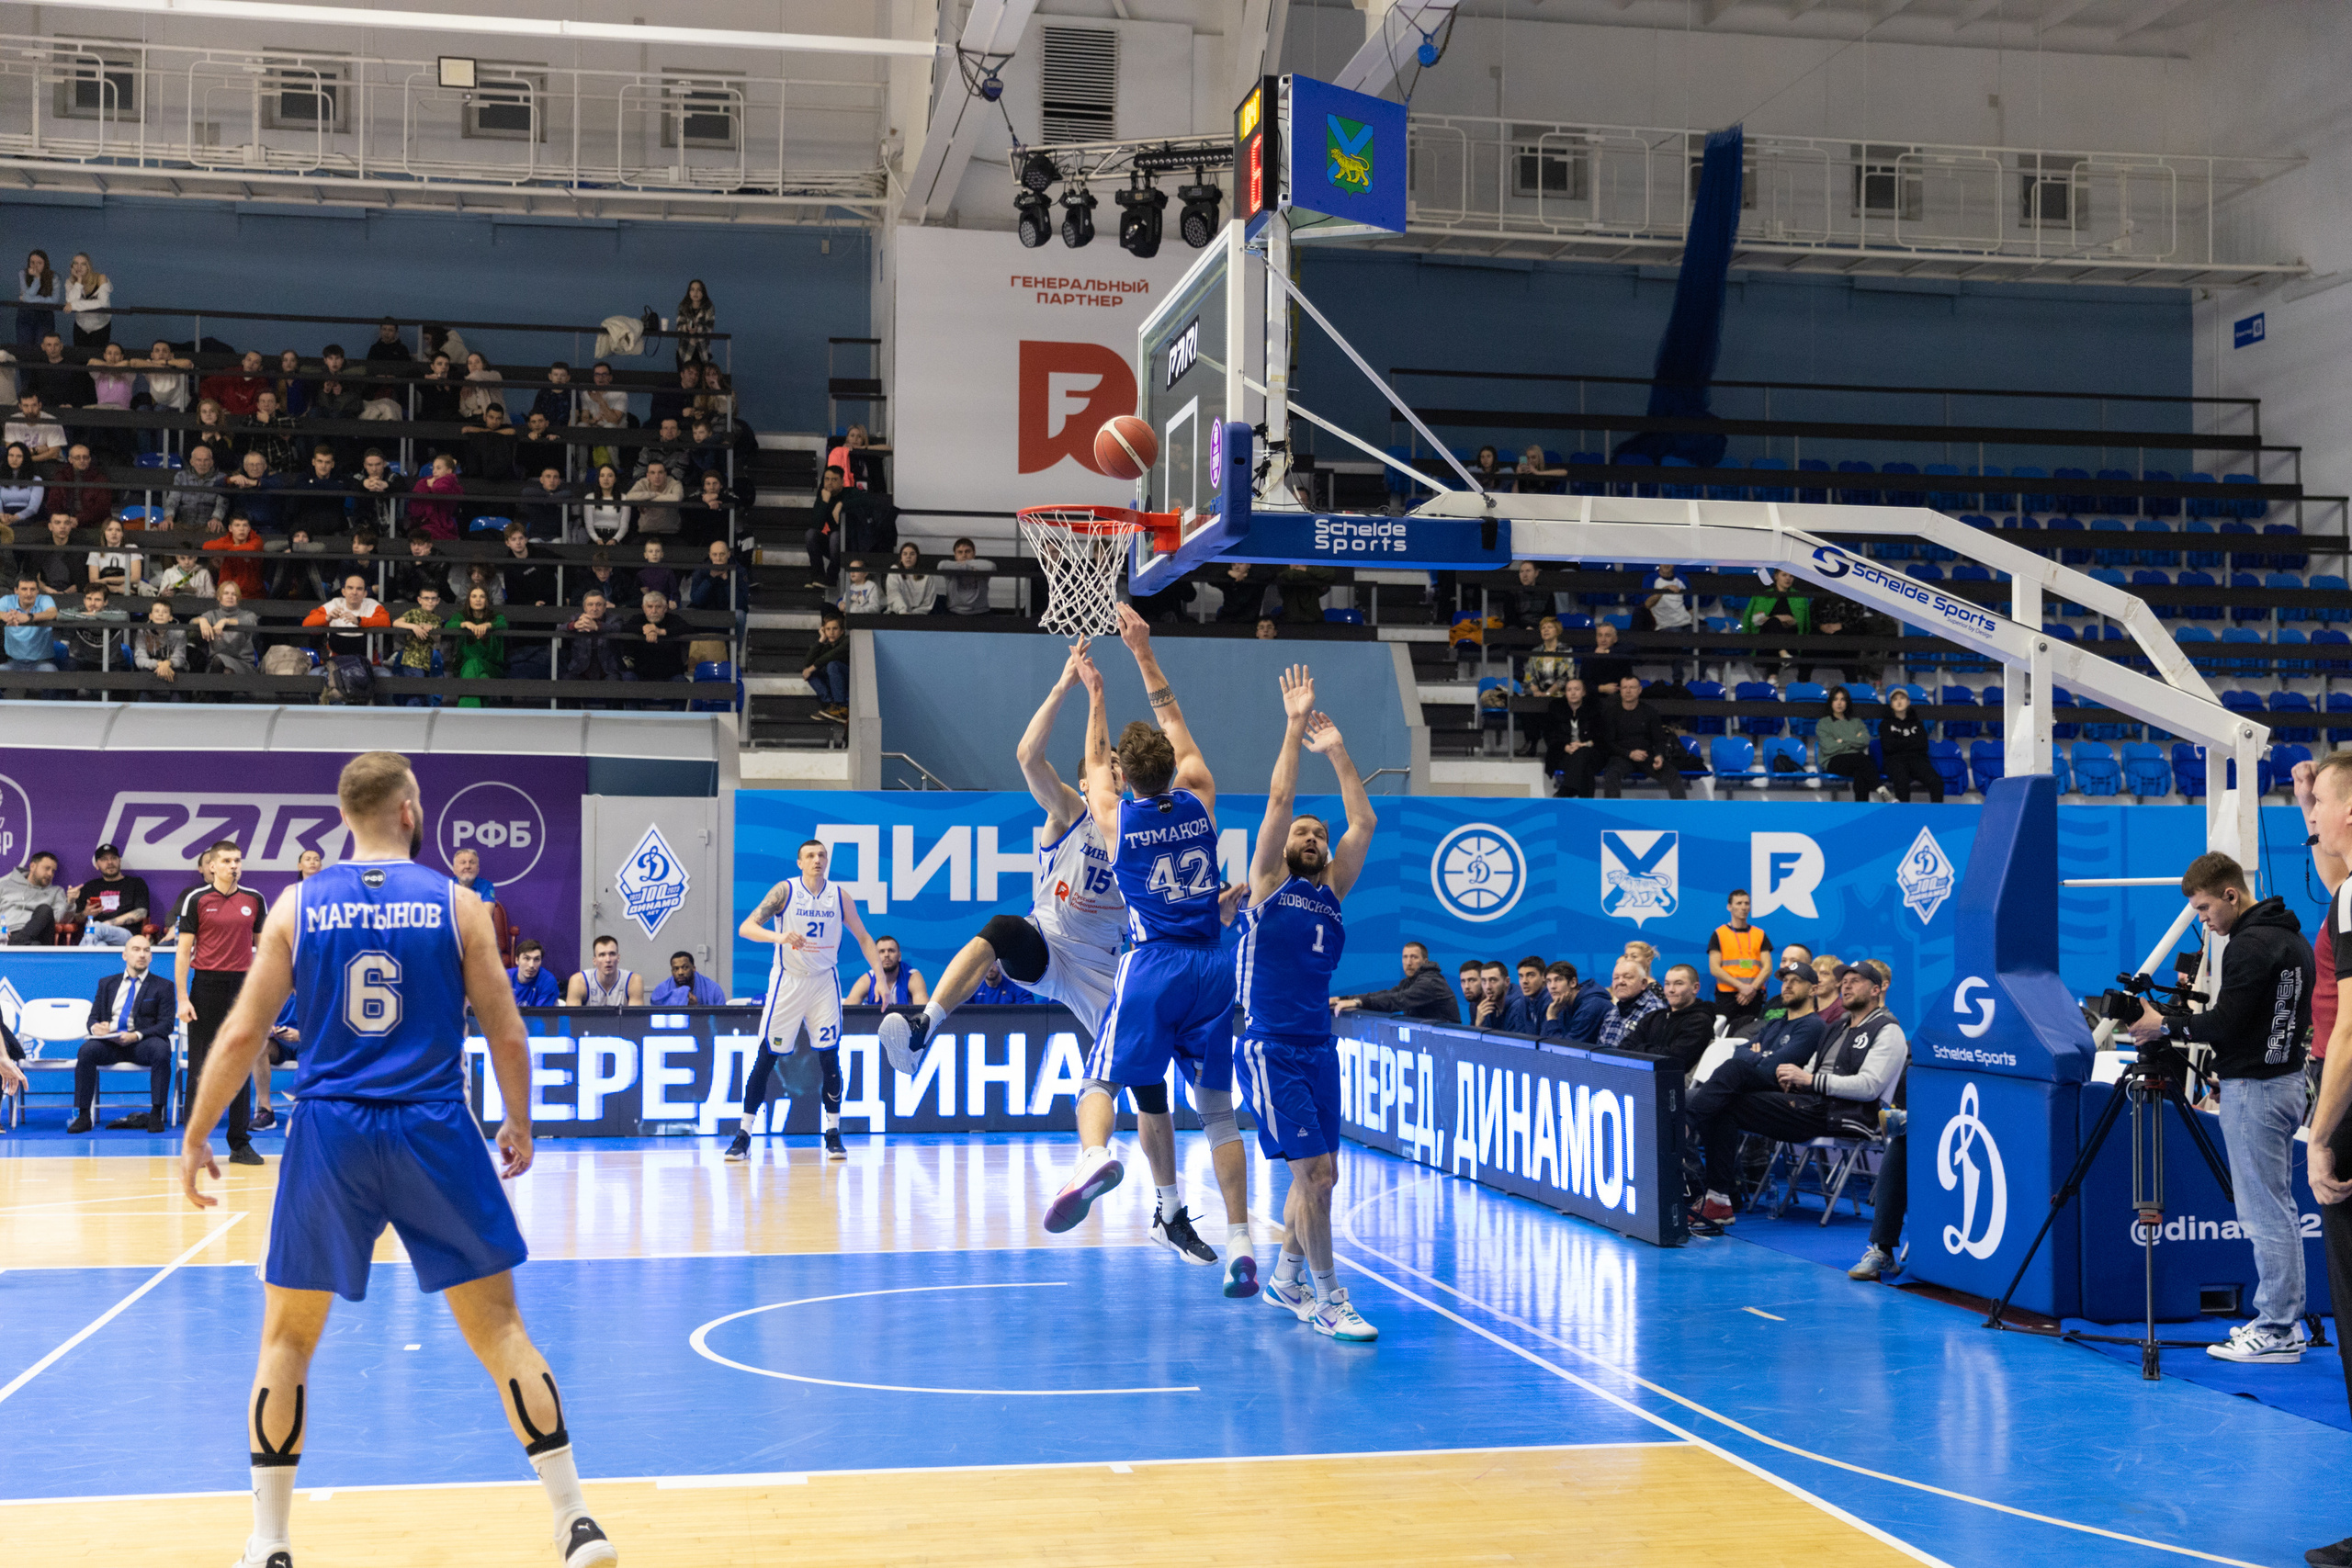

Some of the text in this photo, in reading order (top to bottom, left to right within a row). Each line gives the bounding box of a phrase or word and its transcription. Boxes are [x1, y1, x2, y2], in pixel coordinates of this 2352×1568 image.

[1011, 276, 1149, 294] ГЕНЕРАЛЬНЫЙ
[1036, 291, 1124, 308] ПАРТНЕР
[1315, 518, 1407, 537] Schelde
[1314, 534, 1408, 555] Sports
[1851, 561, 1996, 632] Schelde Sports
[1946, 616, 1993, 639] Superior by Design
[453, 820, 532, 848] РФБ
[1125, 818, 1210, 850] ТУМАНОВ
[1080, 842, 1109, 862] ДИН
[1083, 865, 1114, 896] 15
[1145, 845, 1218, 905] 42
[628, 897, 680, 915] ДИНАМО
[1073, 891, 1096, 904] Русская
[306, 901, 442, 933] МАРТЫНОВ
[796, 908, 835, 919] ДИНАМО
[806, 921, 825, 938] 21
[1312, 923, 1325, 953] 1
[343, 949, 403, 1037] 6
[819, 1024, 838, 1043] 21
[1932, 1044, 2018, 1067] Schelde Sports
[1453, 1059, 1636, 1215] ДИНАМО!
